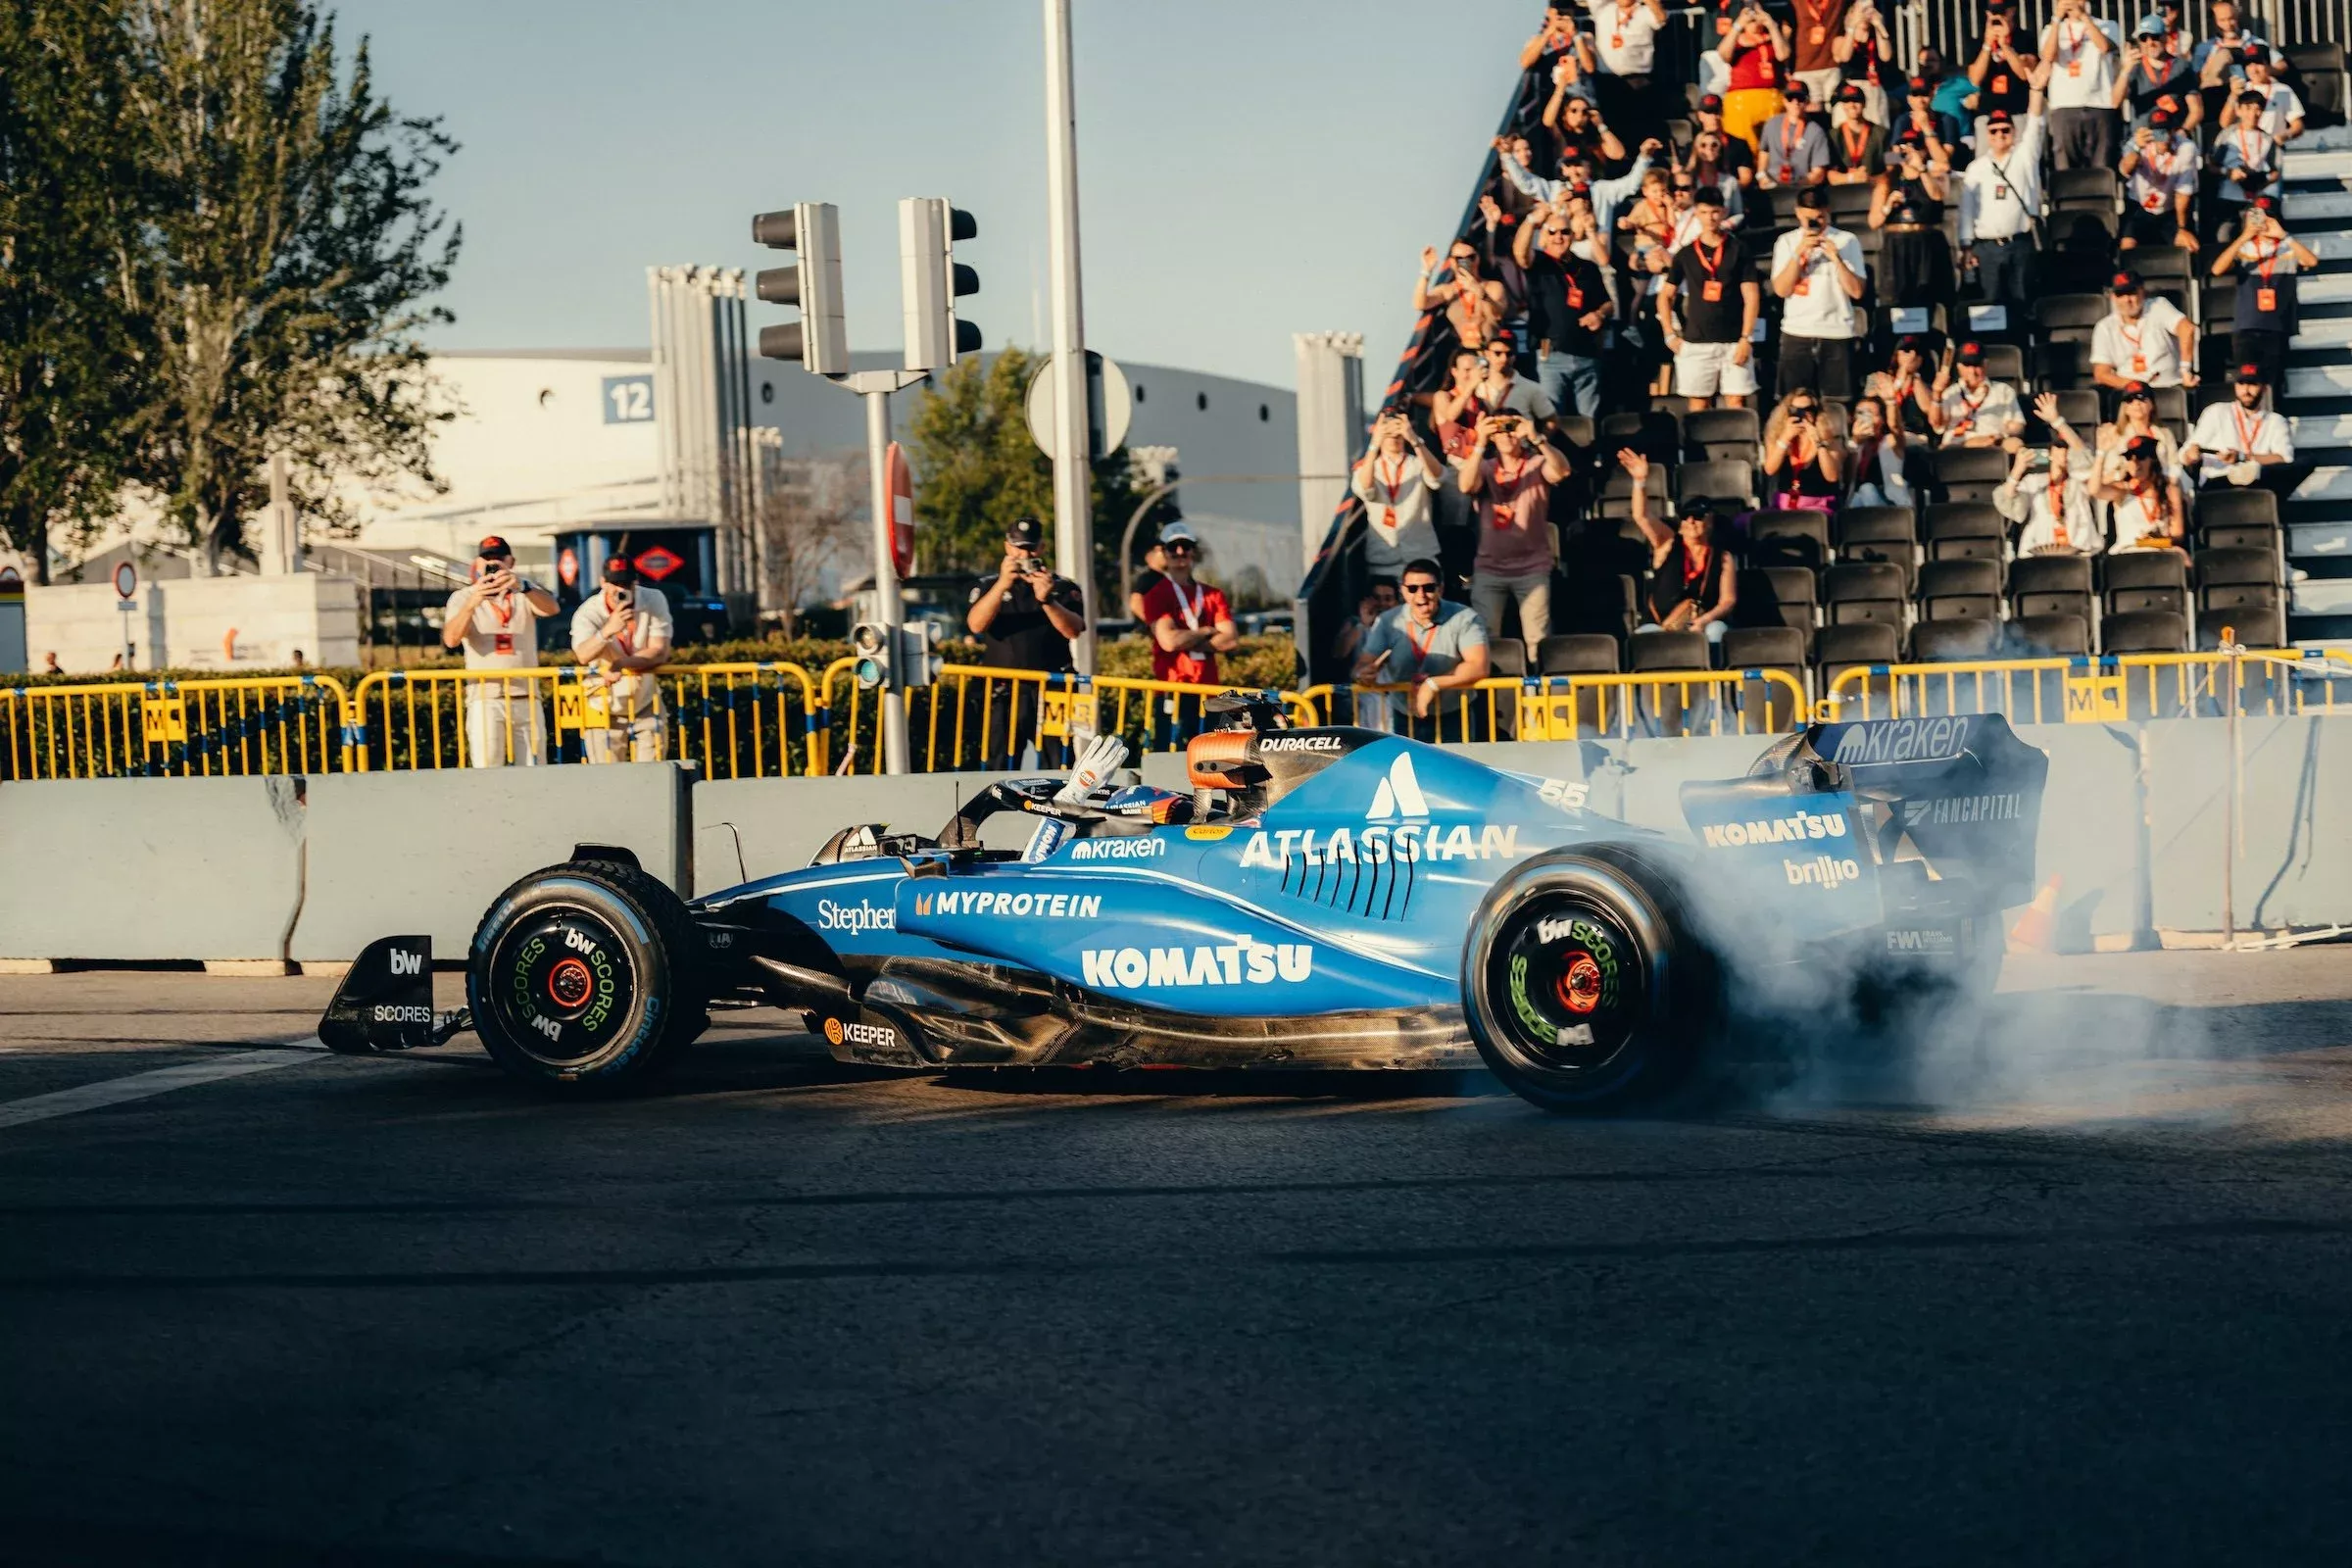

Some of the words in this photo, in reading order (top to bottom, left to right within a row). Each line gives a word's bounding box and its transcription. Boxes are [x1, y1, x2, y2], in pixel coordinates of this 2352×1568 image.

[611, 382, 652, 419] 12
[1259, 737, 1342, 752] DURACELL
[1031, 803, 1061, 816] KEEPER
[1538, 778, 1590, 810] 55
[1935, 793, 2021, 824] FANCAPITAL
[1702, 810, 1846, 848] KOMATSU
[844, 845, 878, 854] ATLASSIAN
[1240, 824, 1518, 868] ATLASSIAN
[936, 891, 1102, 917] MYPROTEIN
[390, 948, 422, 975] bw
[1082, 934, 1313, 989] KOMATSU
[514, 937, 546, 1019] SCORES
[564, 927, 596, 955] bw
[590, 950, 614, 1032] SCORES
[373, 1004, 431, 1023] SCORES
[843, 1023, 895, 1048] KEEPER
